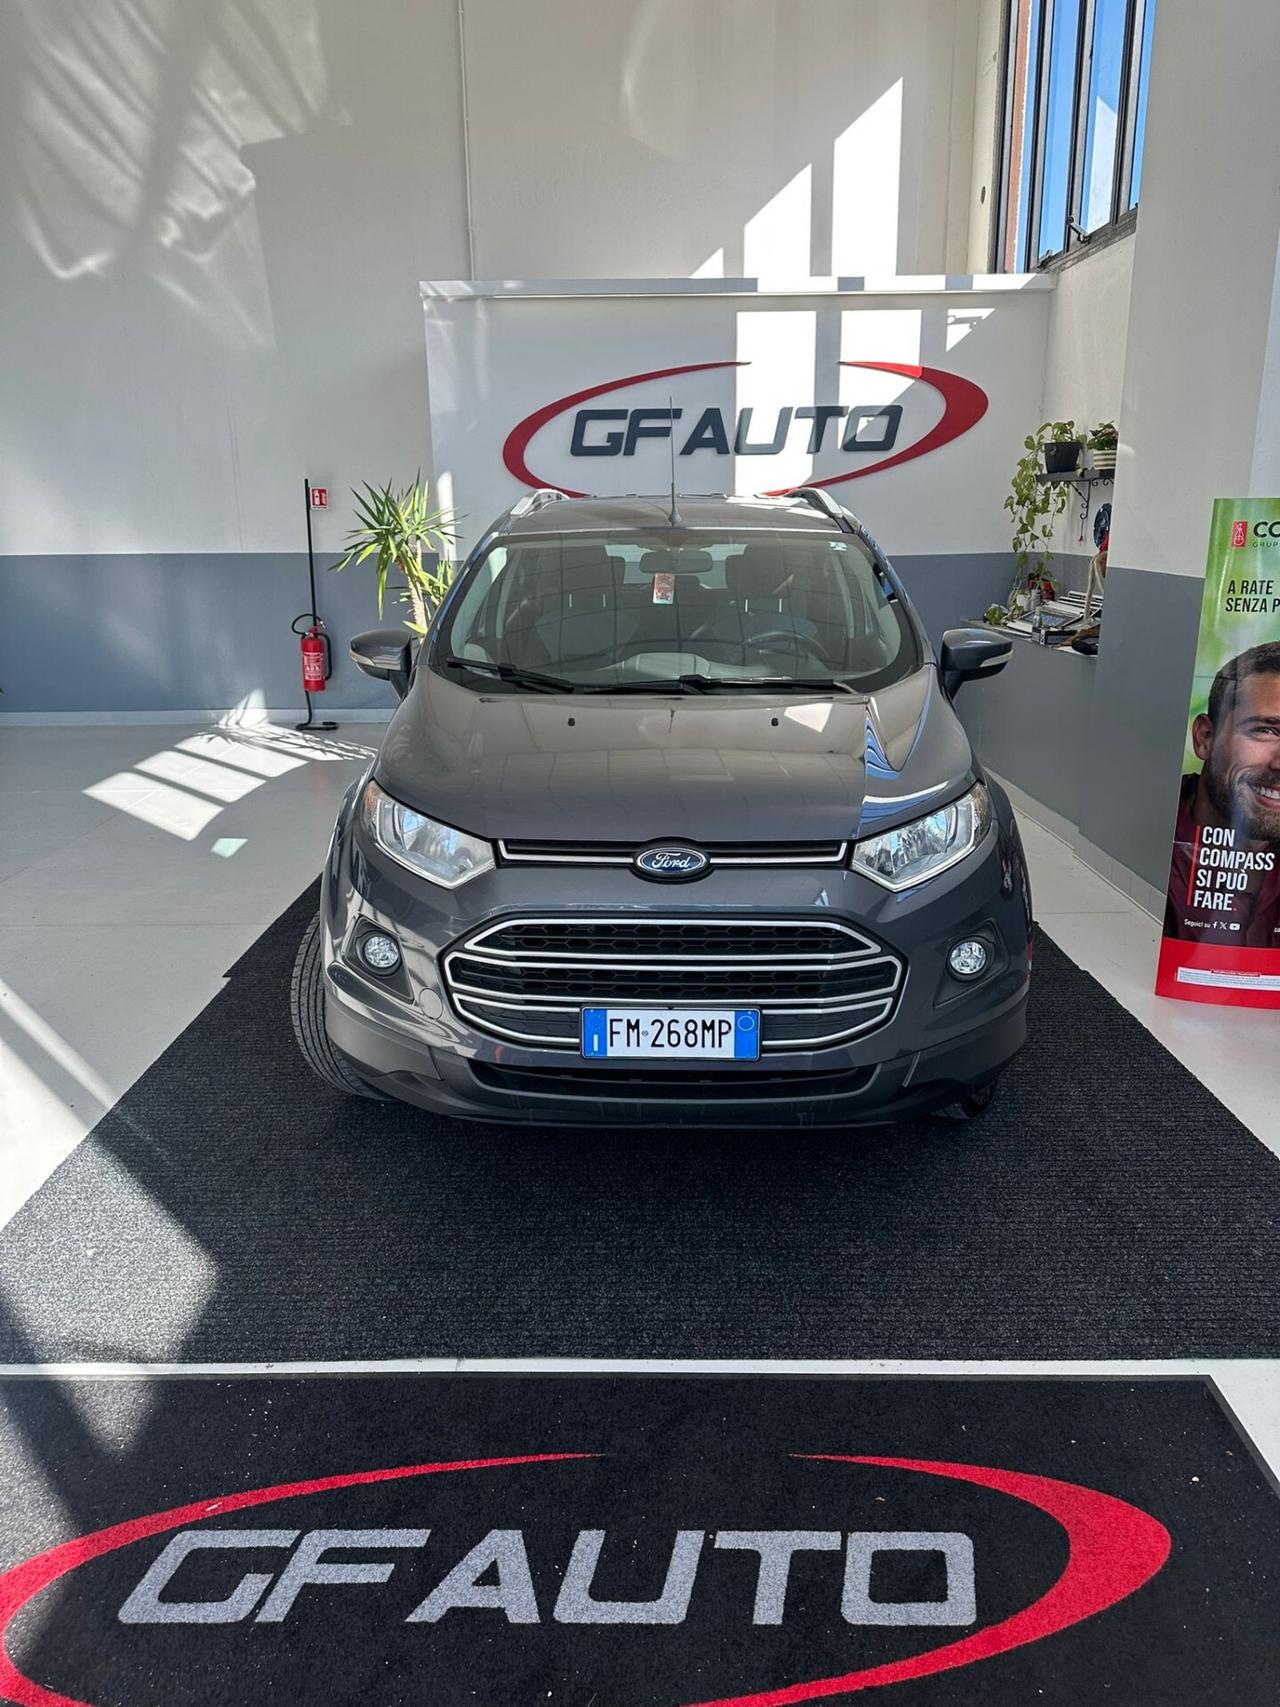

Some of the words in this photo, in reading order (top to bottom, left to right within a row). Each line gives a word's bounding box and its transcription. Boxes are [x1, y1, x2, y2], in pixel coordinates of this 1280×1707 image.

[1227, 580, 1236, 595] A
[1240, 580, 1274, 595] RATE
[1225, 597, 1268, 613] SENZA
[1202, 826, 1235, 847] CON
[651, 852, 690, 868] Ford
[1199, 847, 1275, 871] COMPASS
[1196, 869, 1213, 888] SI
[1215, 869, 1248, 891] PUÒ
[609, 1018, 640, 1048] FM
[650, 1018, 732, 1048] 268MP
